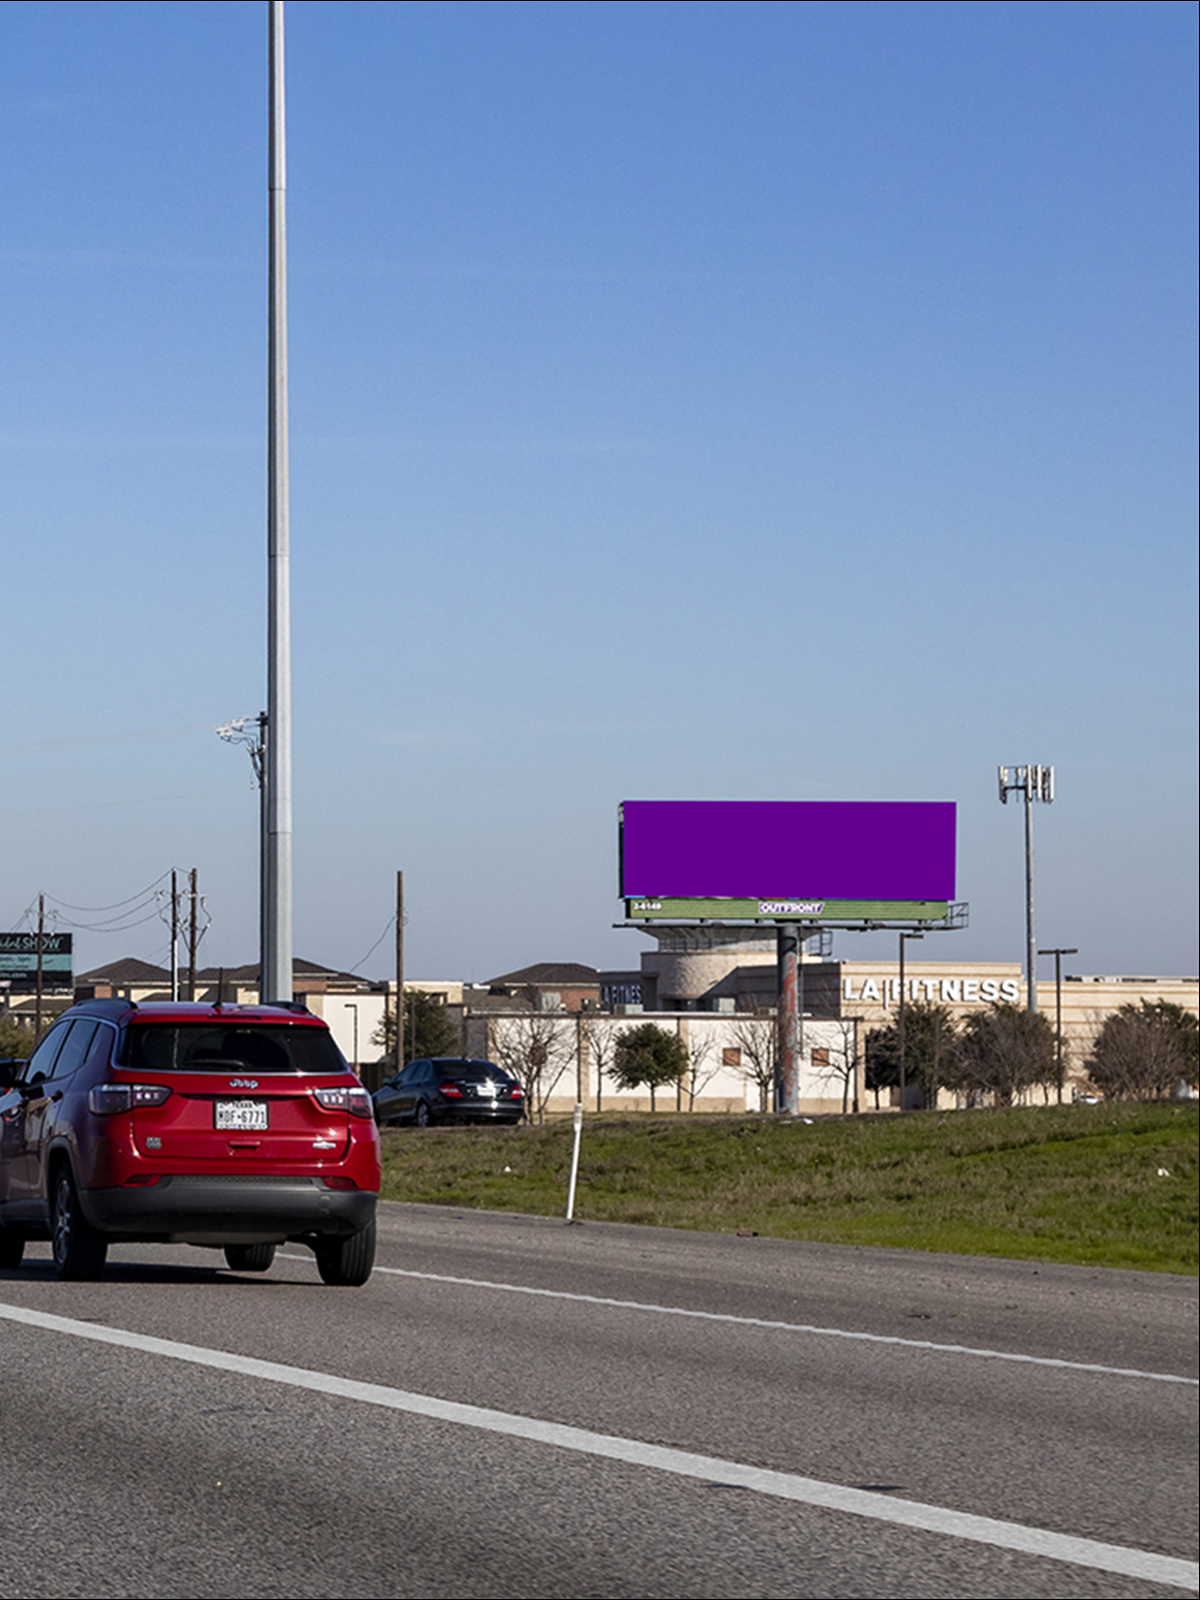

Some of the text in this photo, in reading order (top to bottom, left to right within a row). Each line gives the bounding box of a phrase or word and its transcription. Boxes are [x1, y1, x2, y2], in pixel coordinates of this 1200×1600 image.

[760, 902, 821, 913] OUTFRONT
[843, 979, 1020, 1002] LA FITNESS
[228, 1078, 259, 1089] Jeep
